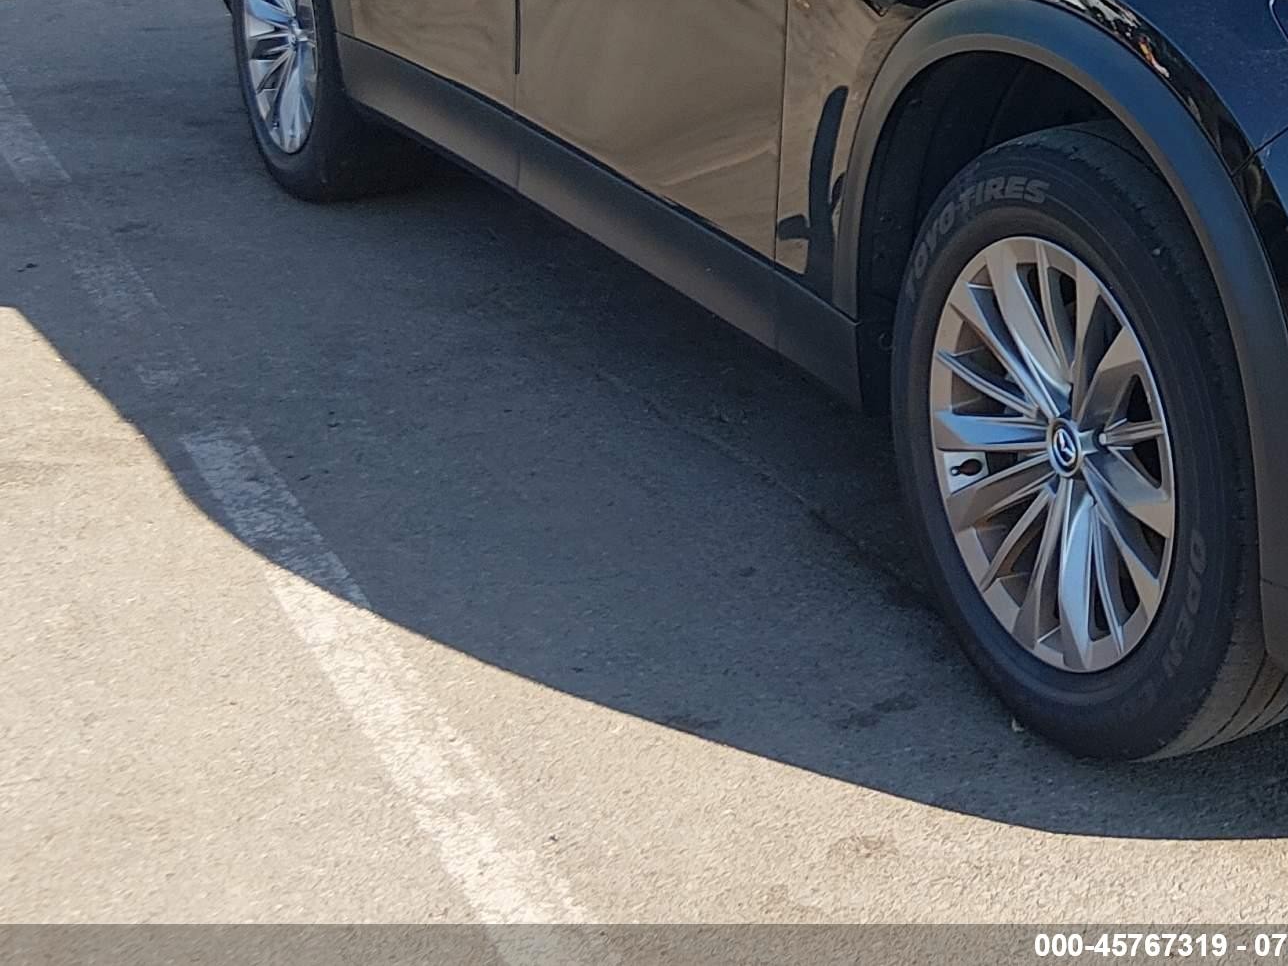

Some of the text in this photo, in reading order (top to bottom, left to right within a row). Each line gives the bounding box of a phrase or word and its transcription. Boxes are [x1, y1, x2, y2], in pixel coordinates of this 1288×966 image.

[904, 175, 1051, 304] TOYO TIRES
[1164, 530, 1207, 679] OPEN
